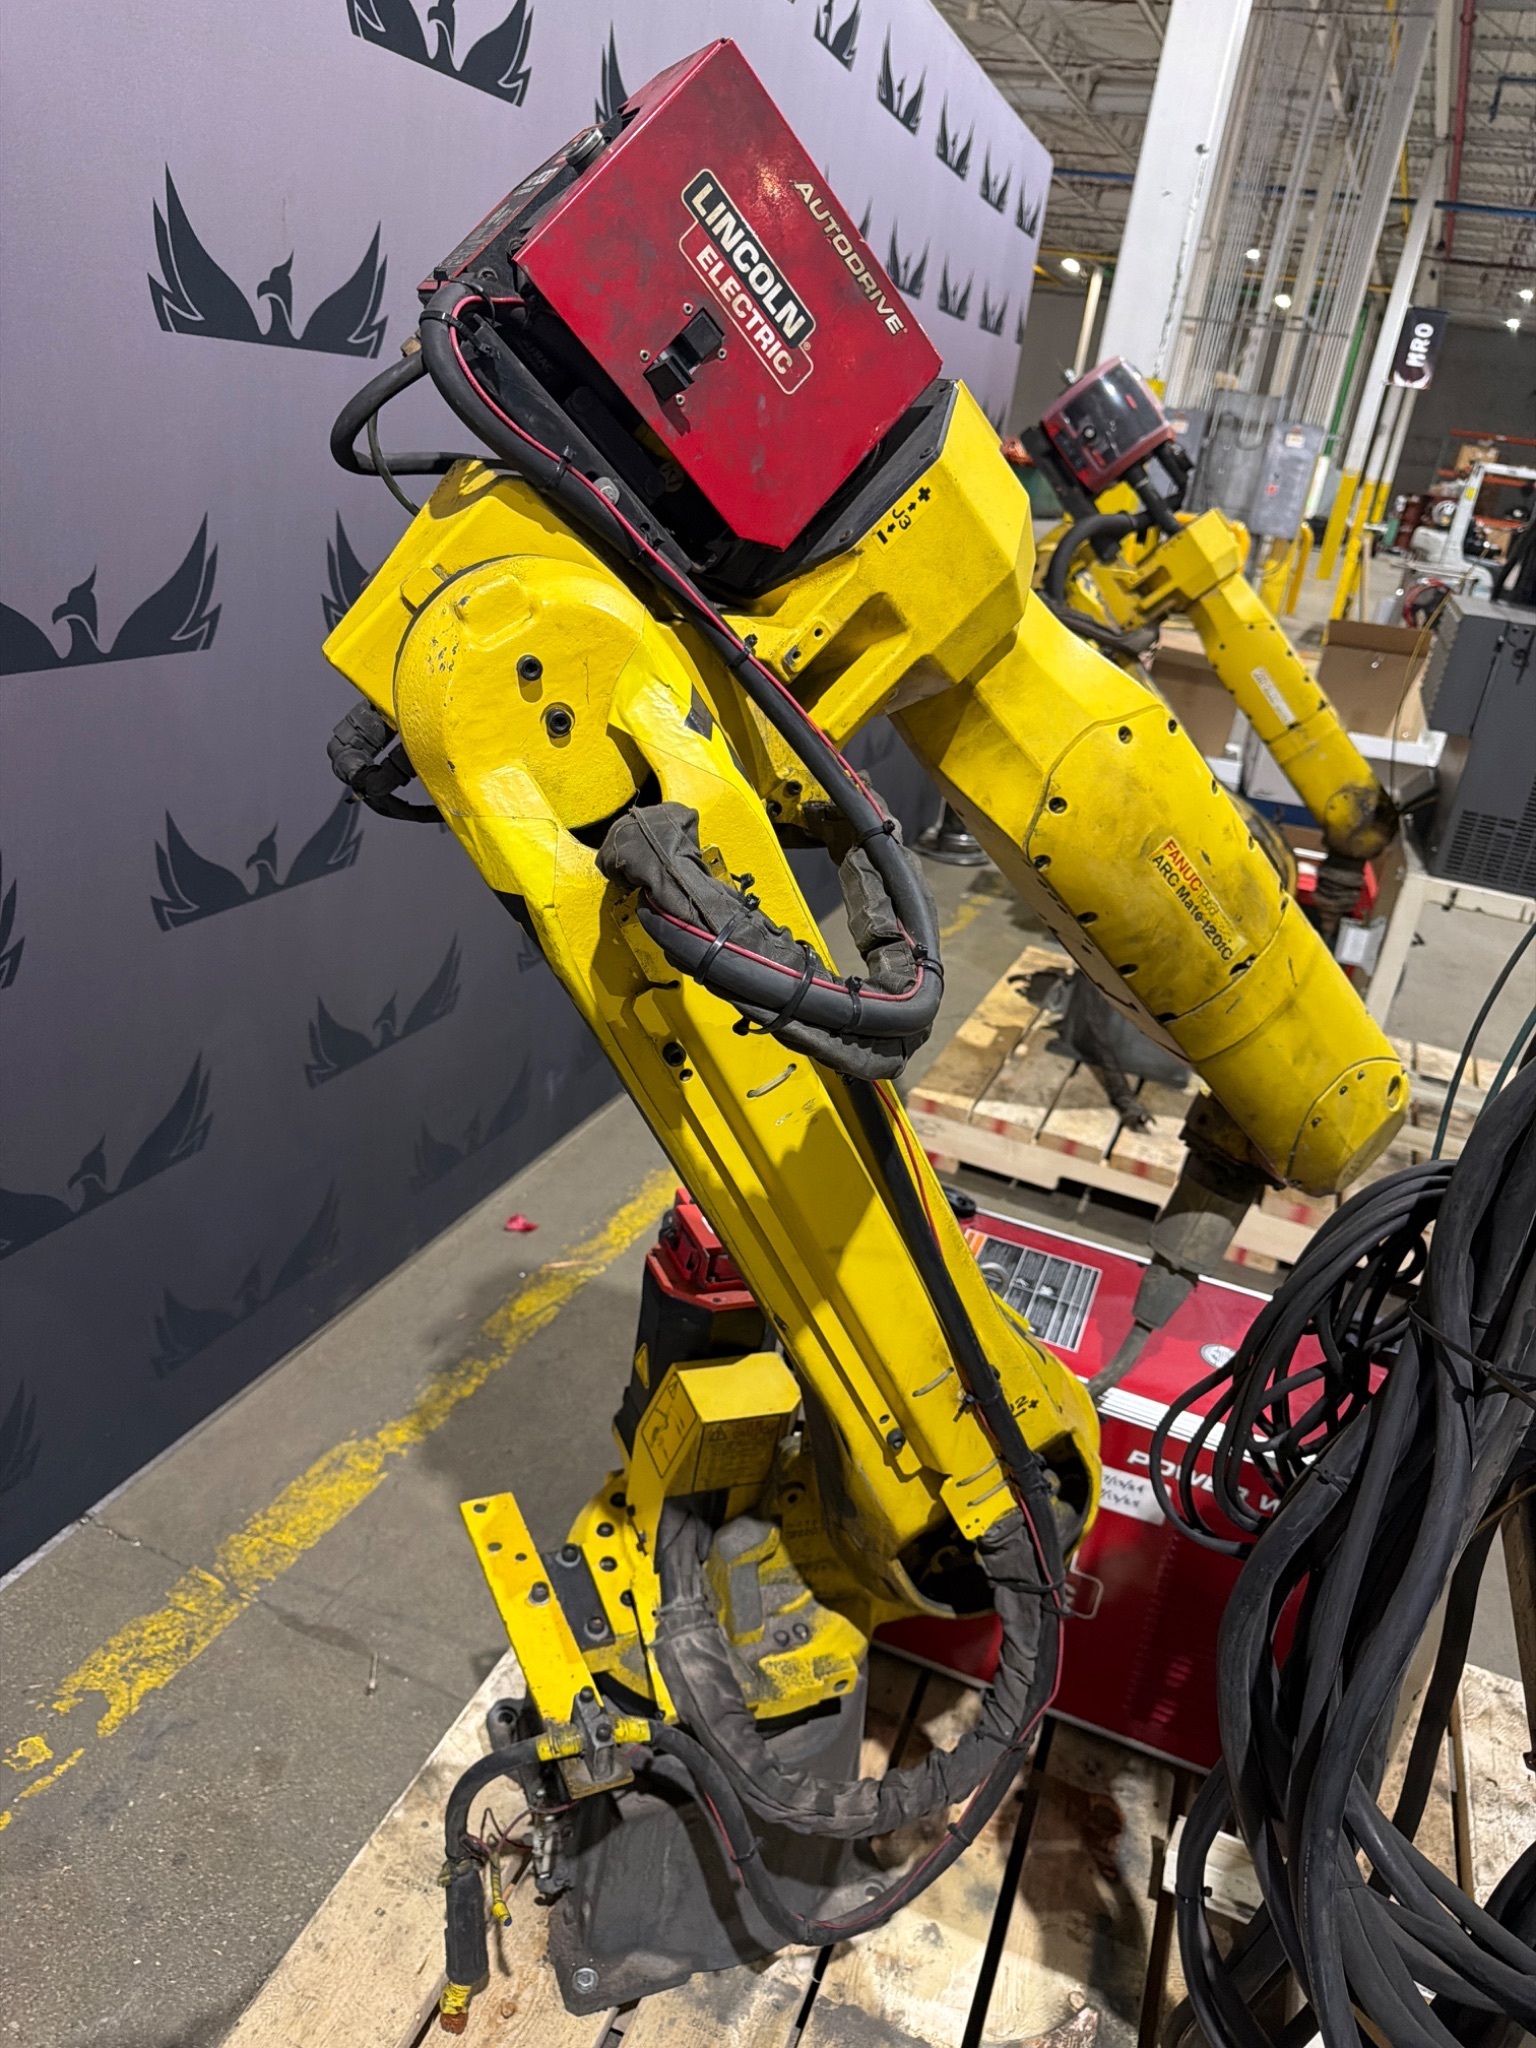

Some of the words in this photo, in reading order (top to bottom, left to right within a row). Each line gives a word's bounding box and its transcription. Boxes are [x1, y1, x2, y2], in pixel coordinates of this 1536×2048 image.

[691, 183, 806, 339] LINCOLN
[794, 182, 905, 335] AUTODRIVE
[696, 244, 793, 375] ELECTRIC
[1405, 322, 1434, 368] MRO
[1152, 854, 1180, 888] ARC
[1163, 839, 1203, 892] FANUC
